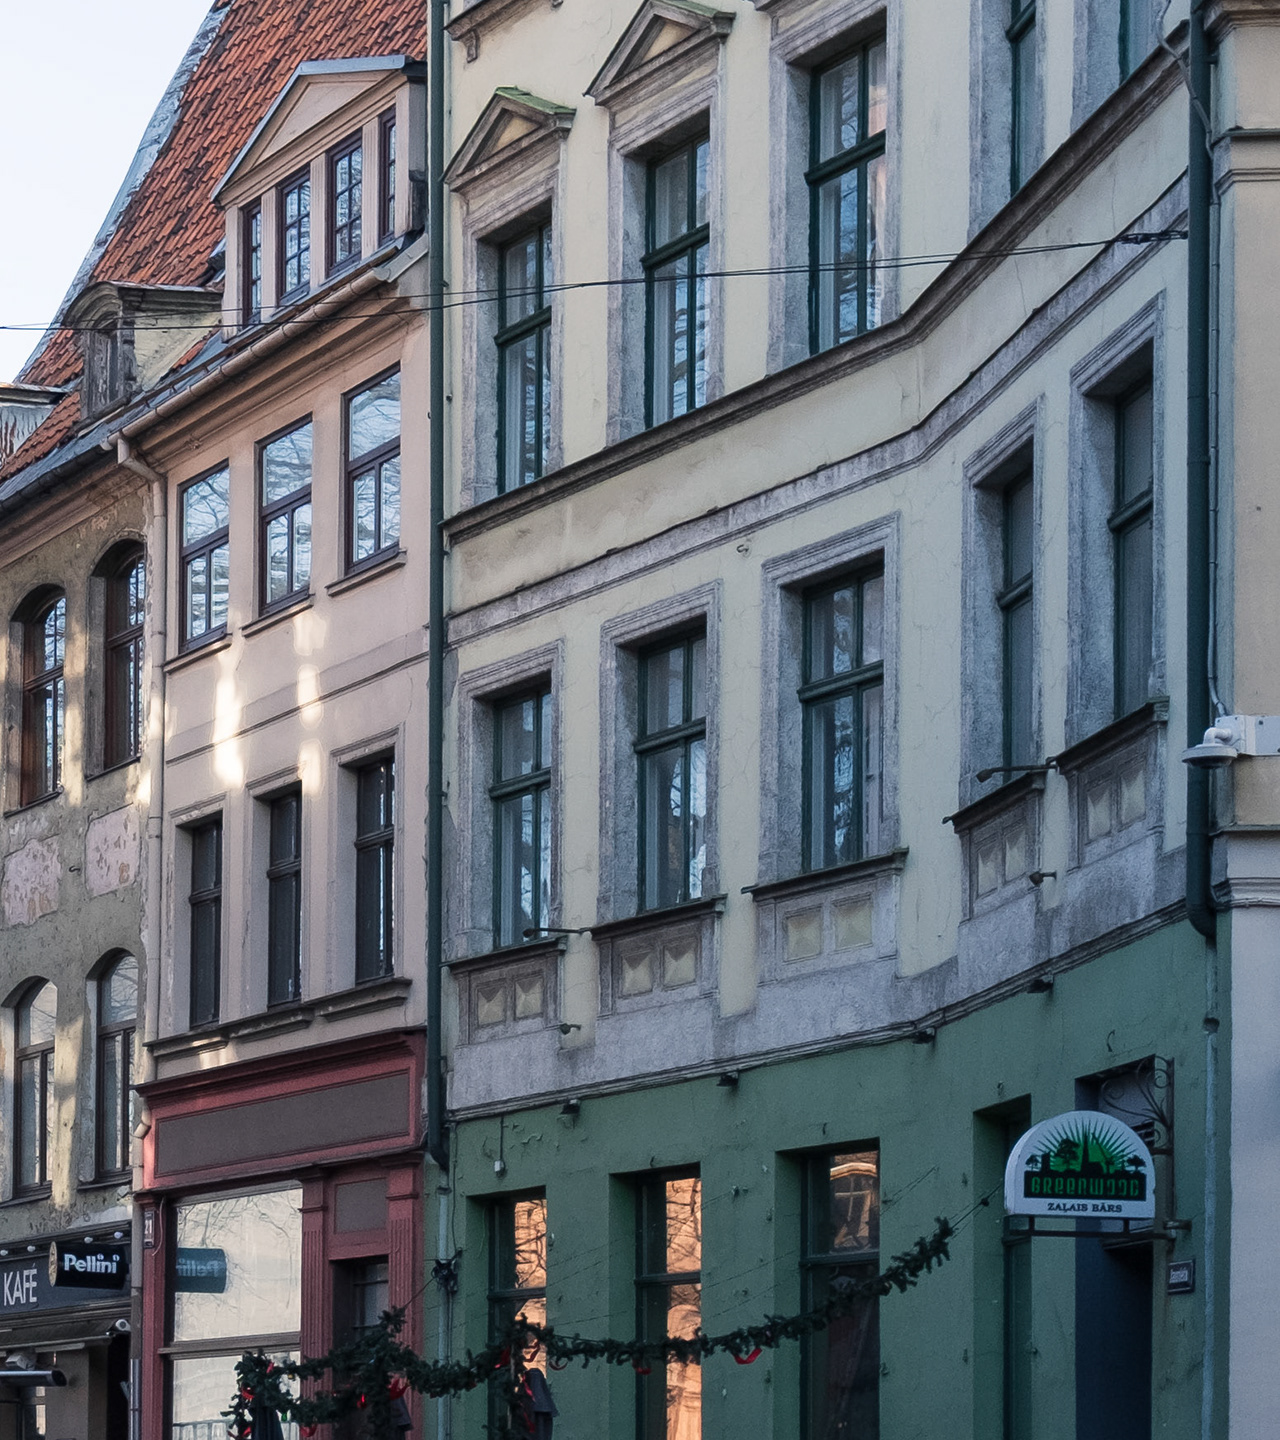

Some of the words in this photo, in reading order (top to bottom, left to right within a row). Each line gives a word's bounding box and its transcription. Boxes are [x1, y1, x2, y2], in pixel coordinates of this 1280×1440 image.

[1048, 1202, 1088, 1213] ZAĻAIS
[1092, 1202, 1122, 1213] BĀRS
[63, 1253, 120, 1275] Pellini
